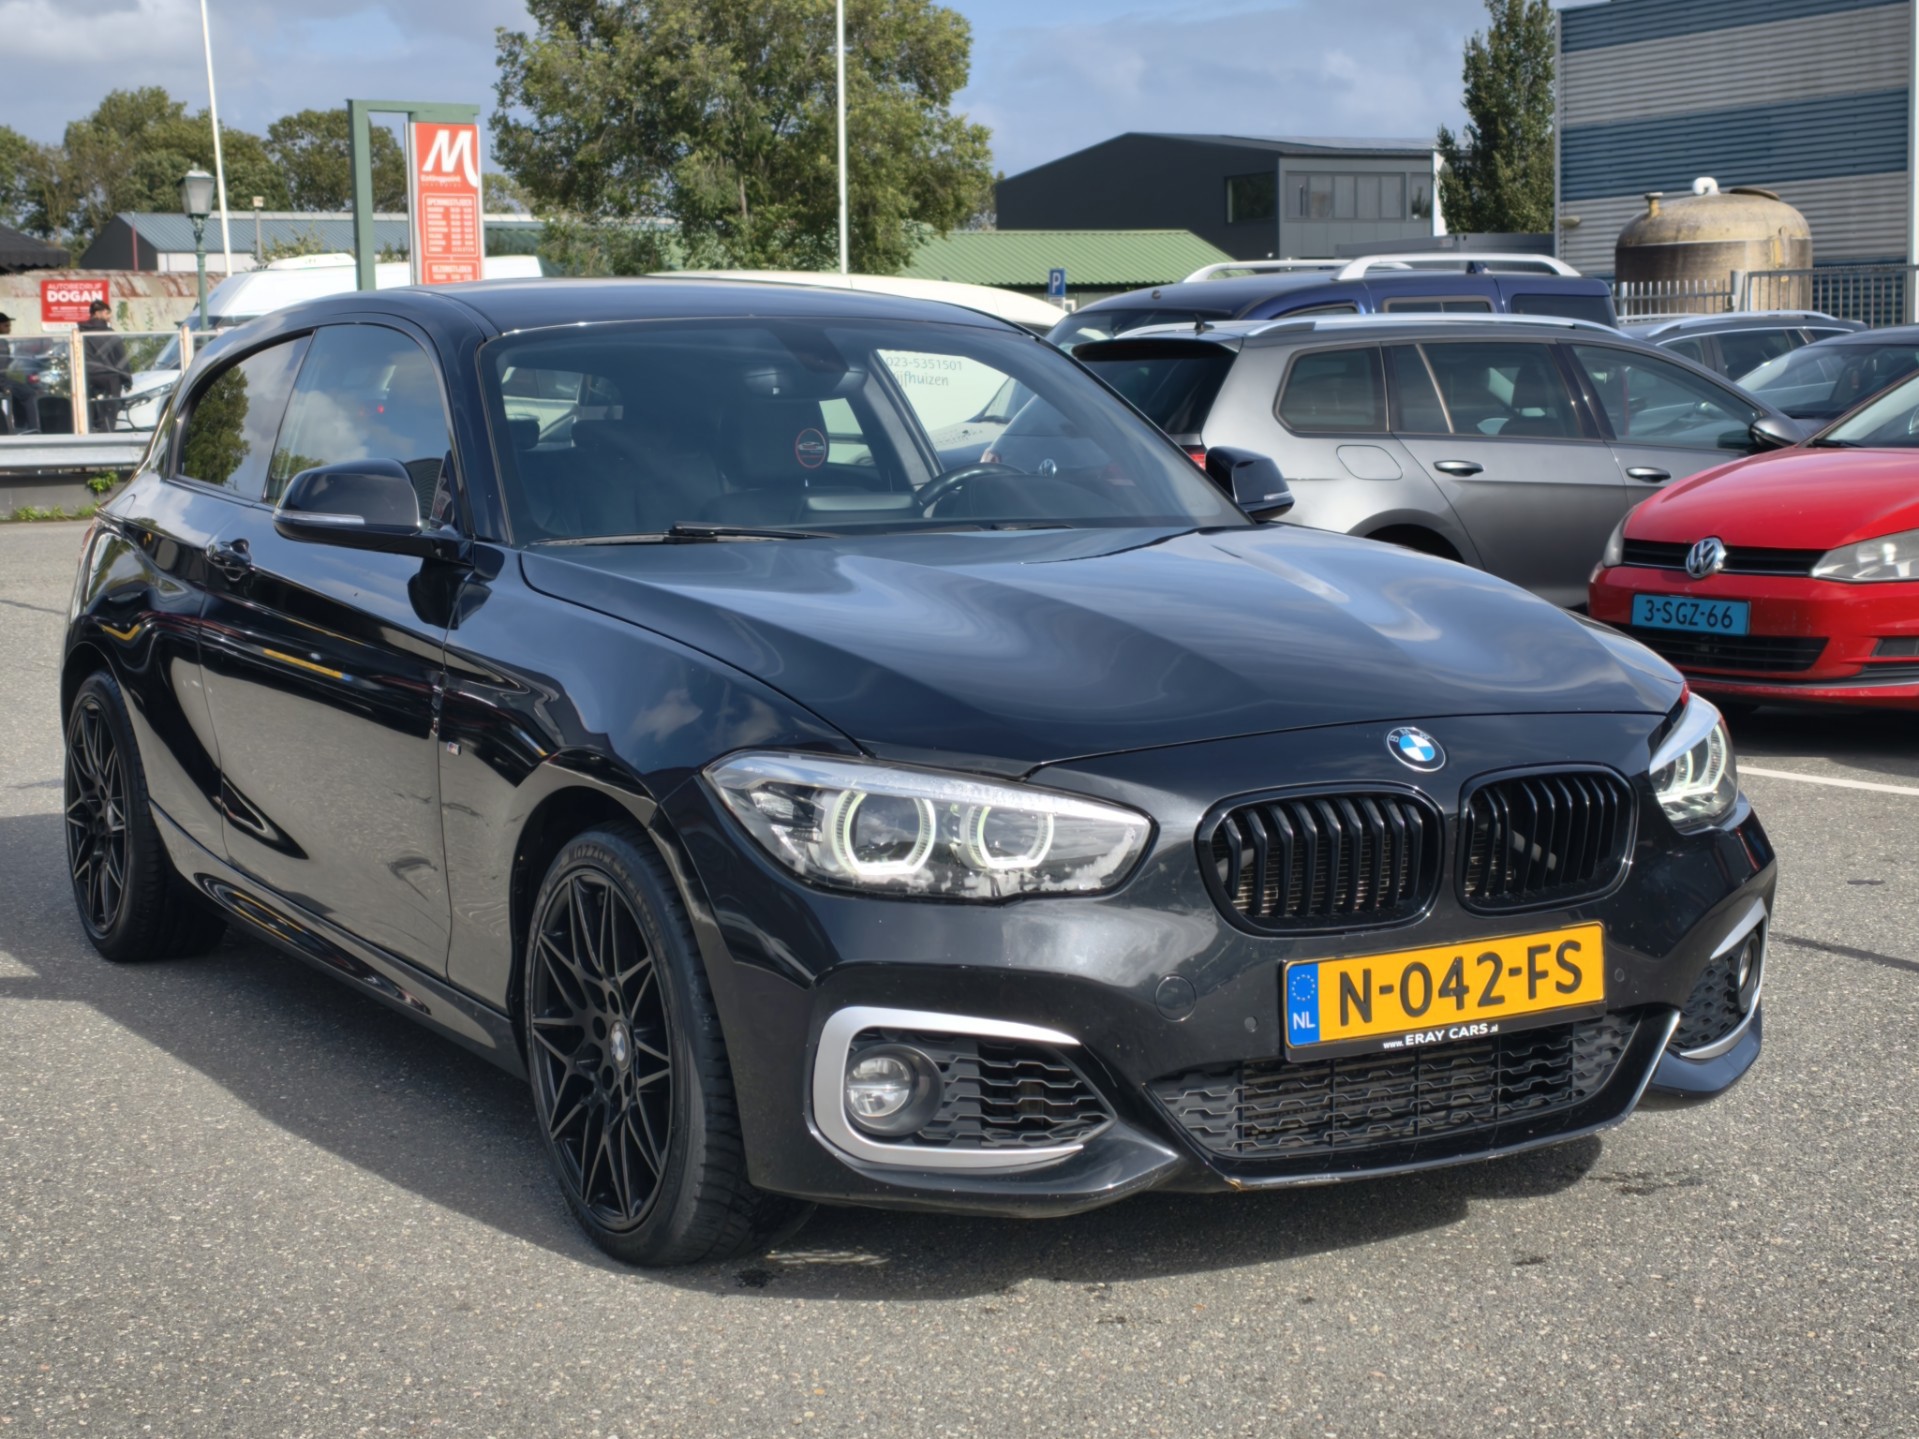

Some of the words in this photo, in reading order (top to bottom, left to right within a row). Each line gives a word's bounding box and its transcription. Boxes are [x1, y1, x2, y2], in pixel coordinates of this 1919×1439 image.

[47, 290, 102, 302] DOGAN
[886, 356, 963, 371] 023-5351501
[1643, 600, 1734, 630] 3-SGZ-66
[1338, 939, 1584, 1028] N-042-FS
[1292, 1011, 1317, 1031] NL
[1405, 1030, 1445, 1046] ERAY
[1449, 1023, 1488, 1039] CARS
